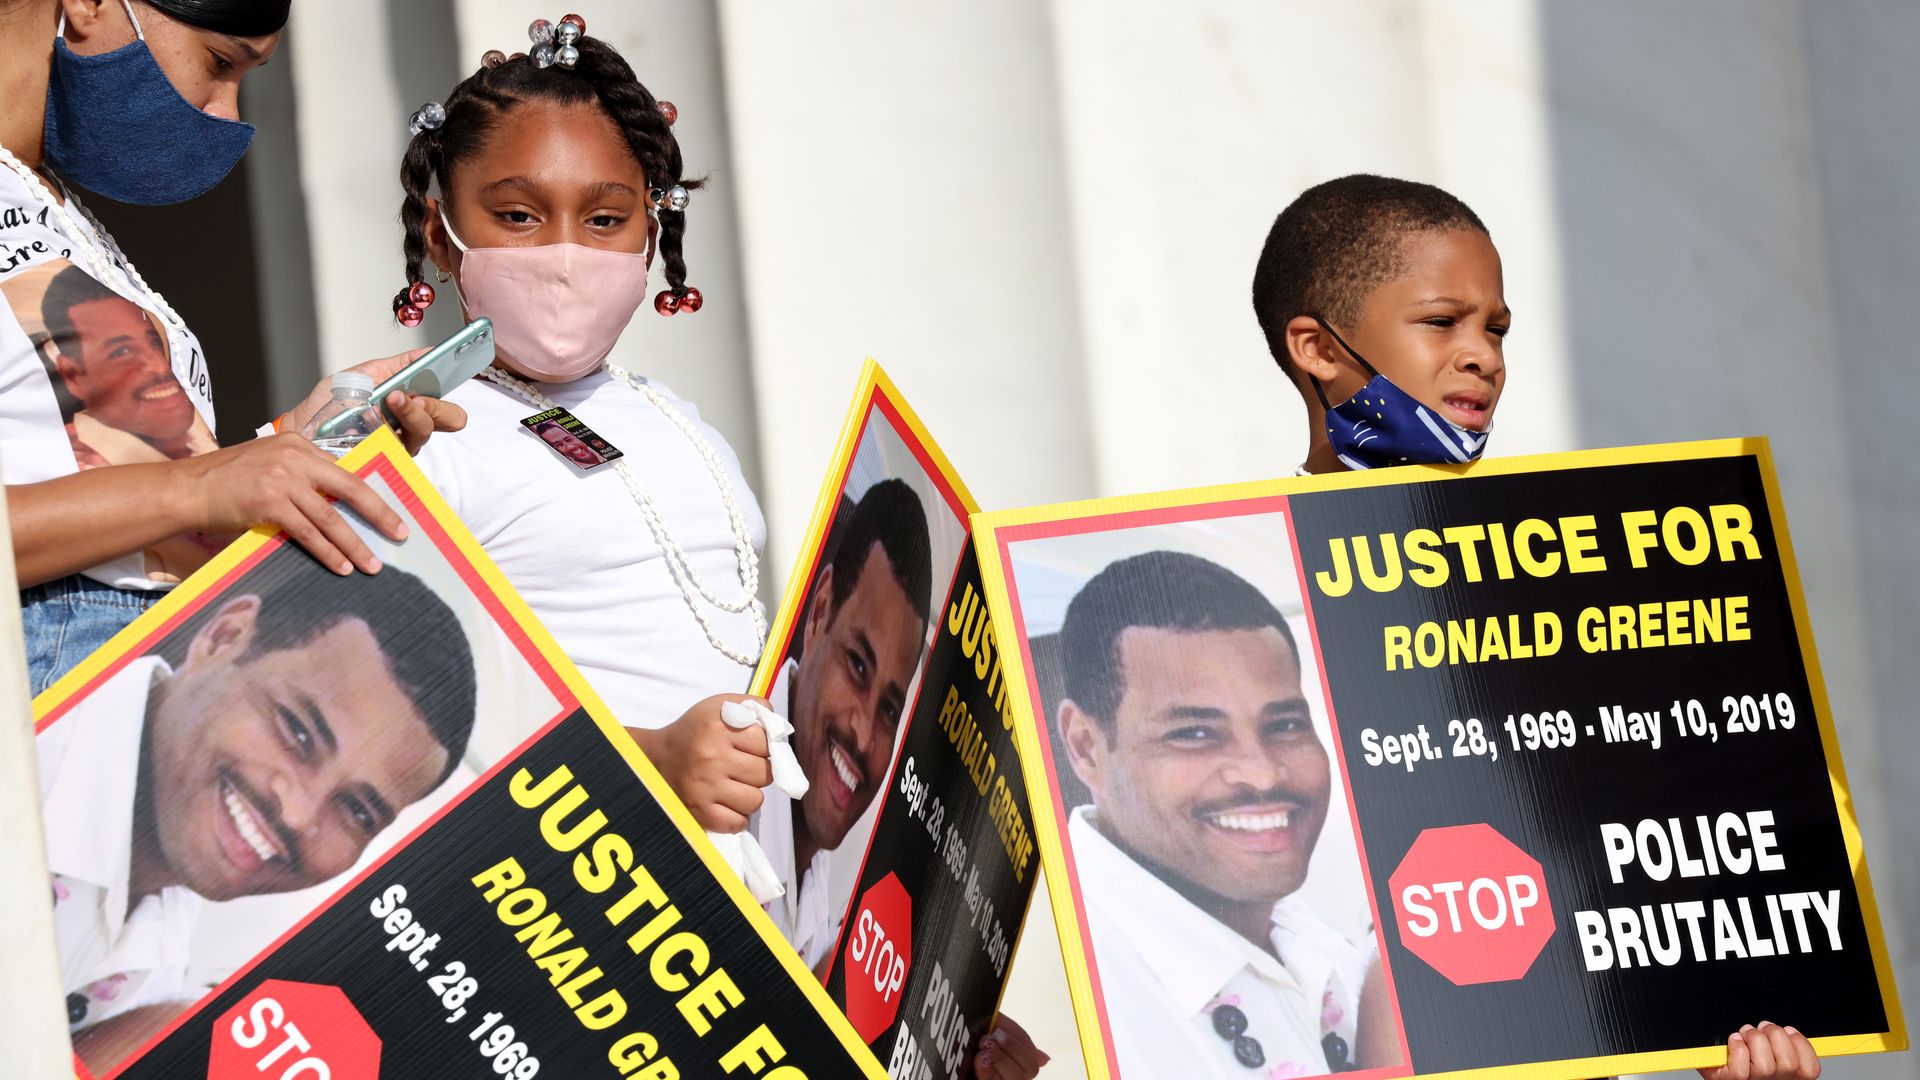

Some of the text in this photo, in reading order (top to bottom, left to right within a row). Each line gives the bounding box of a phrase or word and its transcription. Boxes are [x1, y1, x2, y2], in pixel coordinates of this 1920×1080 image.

[527, 407, 563, 426] JUSTICE
[1315, 503, 1762, 597] JUSTICE FOR
[1384, 595, 1752, 670] RONALD GREENE
[1360, 724, 1443, 773] Sept.
[1447, 719, 1498, 763] 28,
[1503, 709, 1577, 752] 1969
[1599, 705, 1662, 750] May
[1669, 698, 1718, 743] 10,
[1722, 692, 1796, 734] 2019
[938, 684, 1033, 884] RONALD GREENE
[901, 756, 929, 822] Sept.
[926, 796, 945, 853] 28,
[942, 822, 967, 881] 1969
[979, 897, 994, 951] 10,
[988, 919, 1009, 978] 2019
[1599, 810, 1786, 884] POLICE
[471, 856, 628, 1031] RONALD
[508, 764, 746, 1038] JUSTICE
[1402, 874, 1539, 938] STOP
[1573, 889, 1843, 972] BRUTALITY
[369, 883, 540, 1080] Sept. 28, 1969
[852, 909, 905, 1004] STOP
[920, 961, 970, 1080] POLICE
